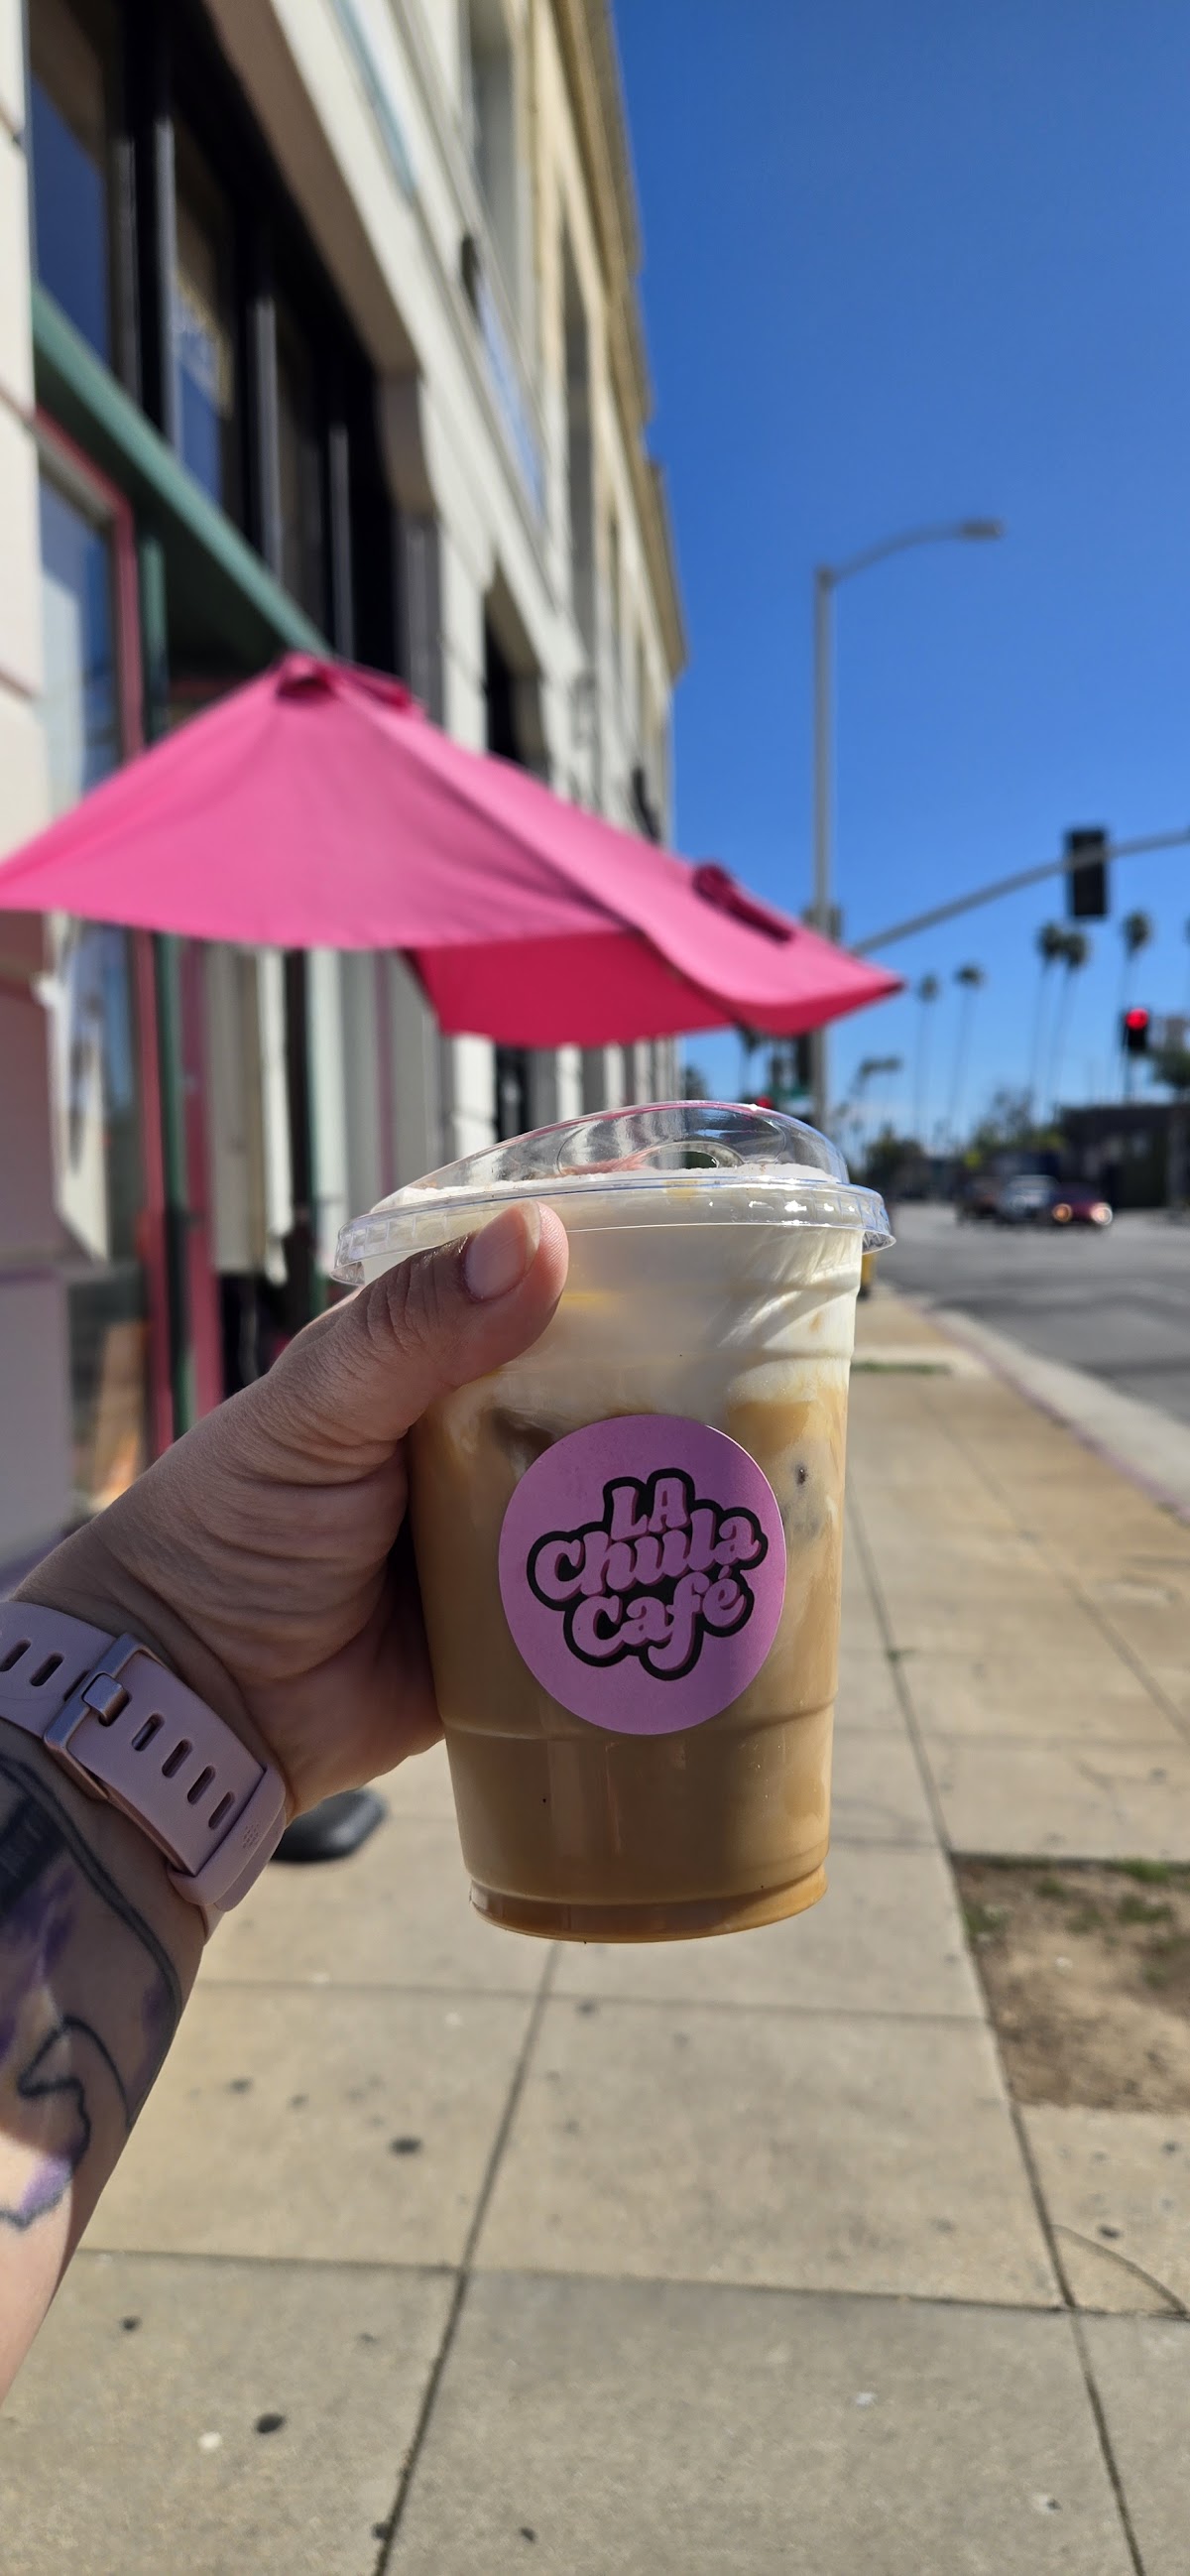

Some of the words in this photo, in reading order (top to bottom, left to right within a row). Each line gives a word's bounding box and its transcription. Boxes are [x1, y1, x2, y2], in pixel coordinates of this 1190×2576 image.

[535, 1508, 761, 1601] Chula
[611, 1476, 691, 1541] LA
[571, 1565, 749, 1671] Café
